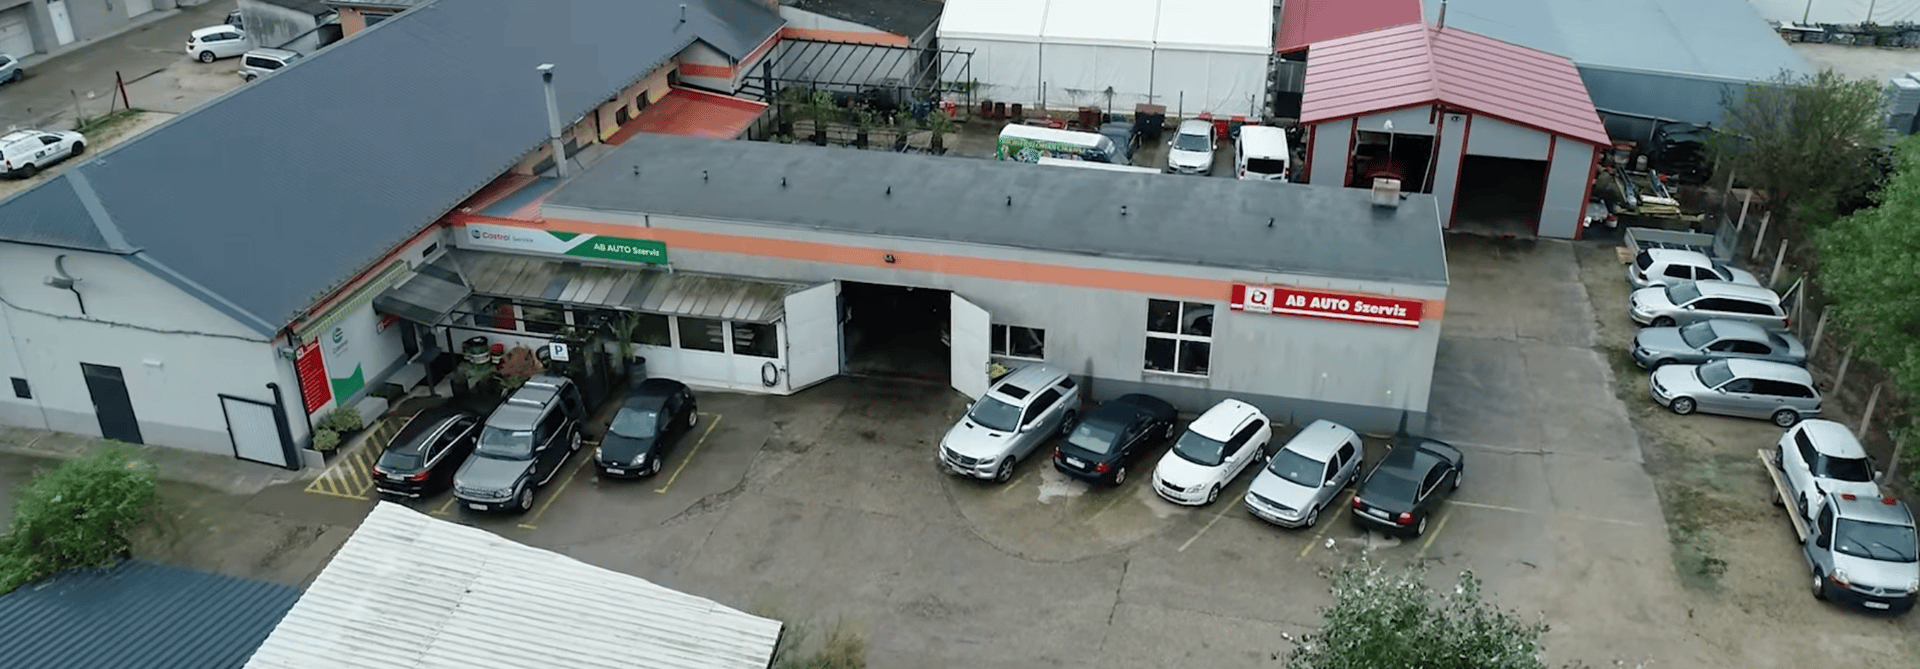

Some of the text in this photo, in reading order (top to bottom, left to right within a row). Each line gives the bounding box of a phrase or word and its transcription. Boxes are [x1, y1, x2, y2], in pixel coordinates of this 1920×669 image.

[593, 243, 660, 256] AB AUTO Szerviz
[1285, 294, 1407, 317] AB AUTO Szerviz
[554, 345, 563, 355] P
